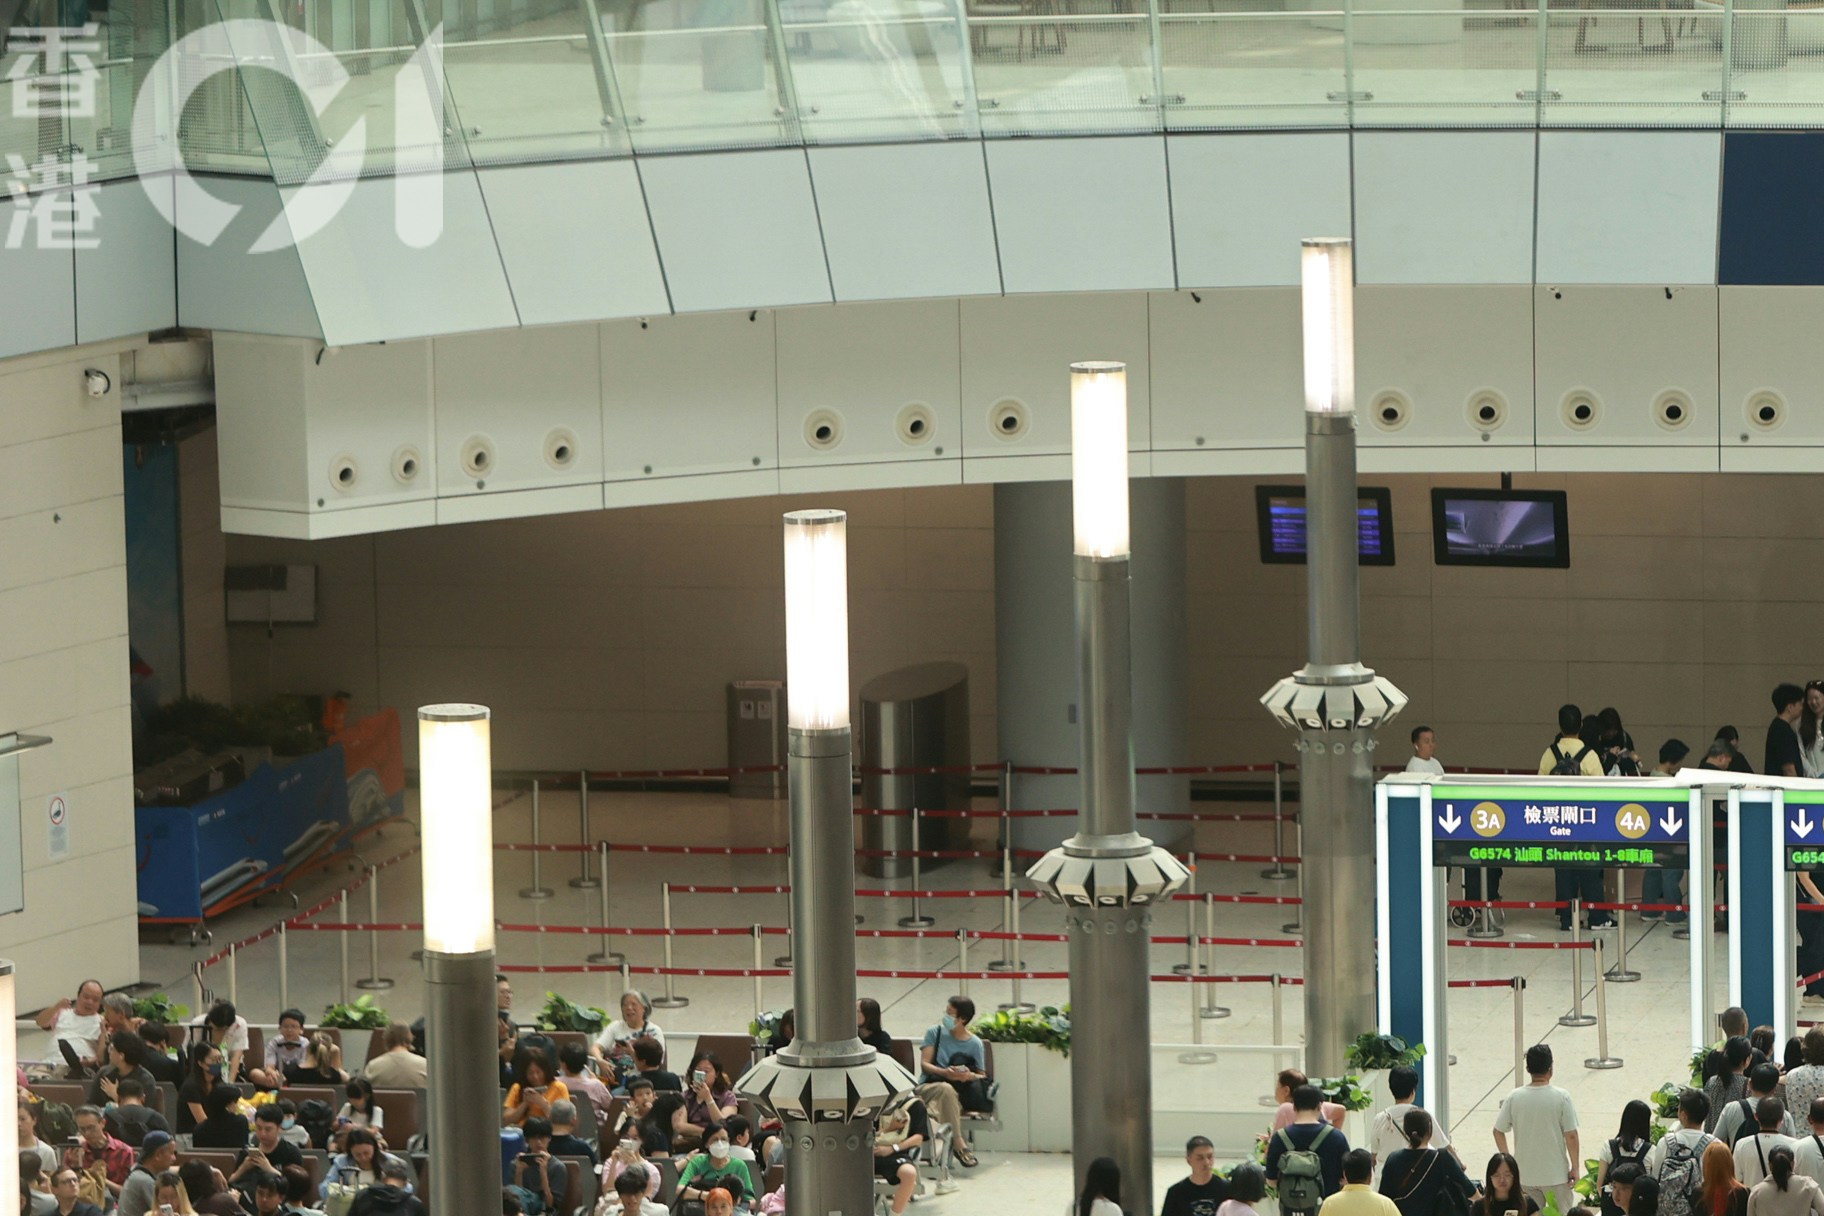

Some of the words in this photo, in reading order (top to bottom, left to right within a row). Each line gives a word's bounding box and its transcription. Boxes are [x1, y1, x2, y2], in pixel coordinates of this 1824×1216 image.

[1476, 810, 1501, 829] 3A
[1524, 805, 1597, 824] 檢票閘口
[1619, 811, 1646, 831] 4A
[1550, 825, 1571, 836] Gate
[1469, 847, 1512, 861] G6574
[1546, 847, 1600, 861] Shantou
